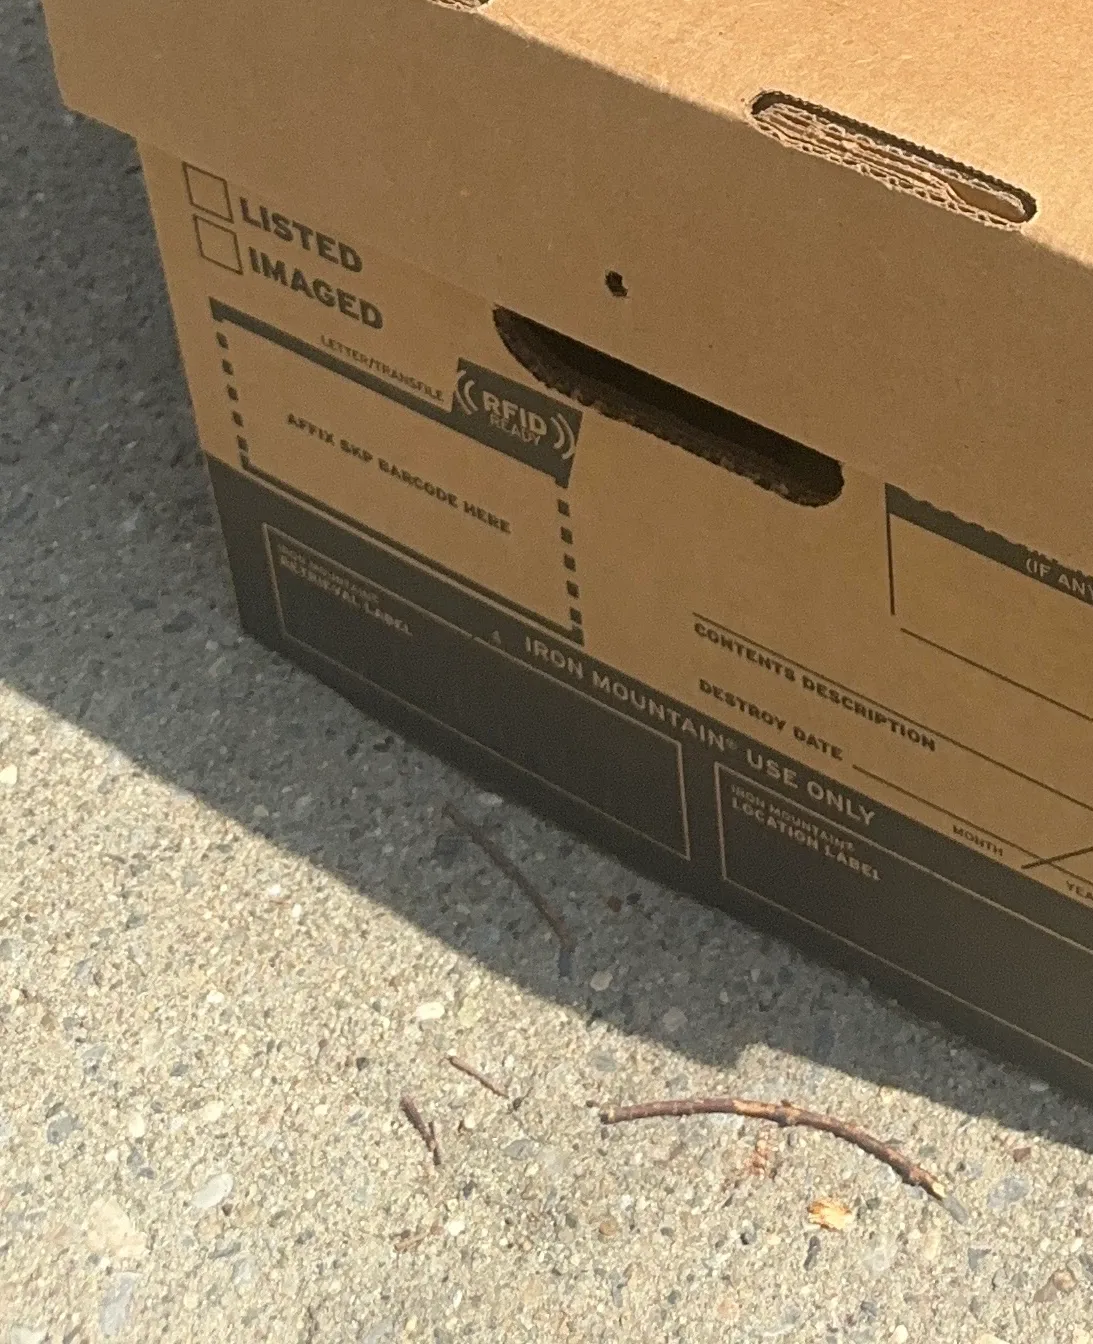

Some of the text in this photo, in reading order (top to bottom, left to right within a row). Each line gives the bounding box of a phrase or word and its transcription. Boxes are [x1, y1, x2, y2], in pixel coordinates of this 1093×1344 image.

[239, 196, 363, 273] LISTED
[248, 245, 383, 330] IMAGED
[482, 390, 547, 436] RFID
[287, 413, 335, 447] AFFIX
[377, 457, 458, 509] BARCODE
[462, 500, 511, 534] HERE
[1025, 557, 1051, 578] (IF
[694, 622, 937, 753] CONTENTS DESCRIPTION
[699, 678, 843, 762] DESTROY DATE
[525, 635, 584, 681] IRON
[746, 748, 799, 790] USE
[807, 779, 876, 827] ONLY
[731, 796, 881, 883] LOCATION LABEL
[952, 824, 1004, 857] MONTH
